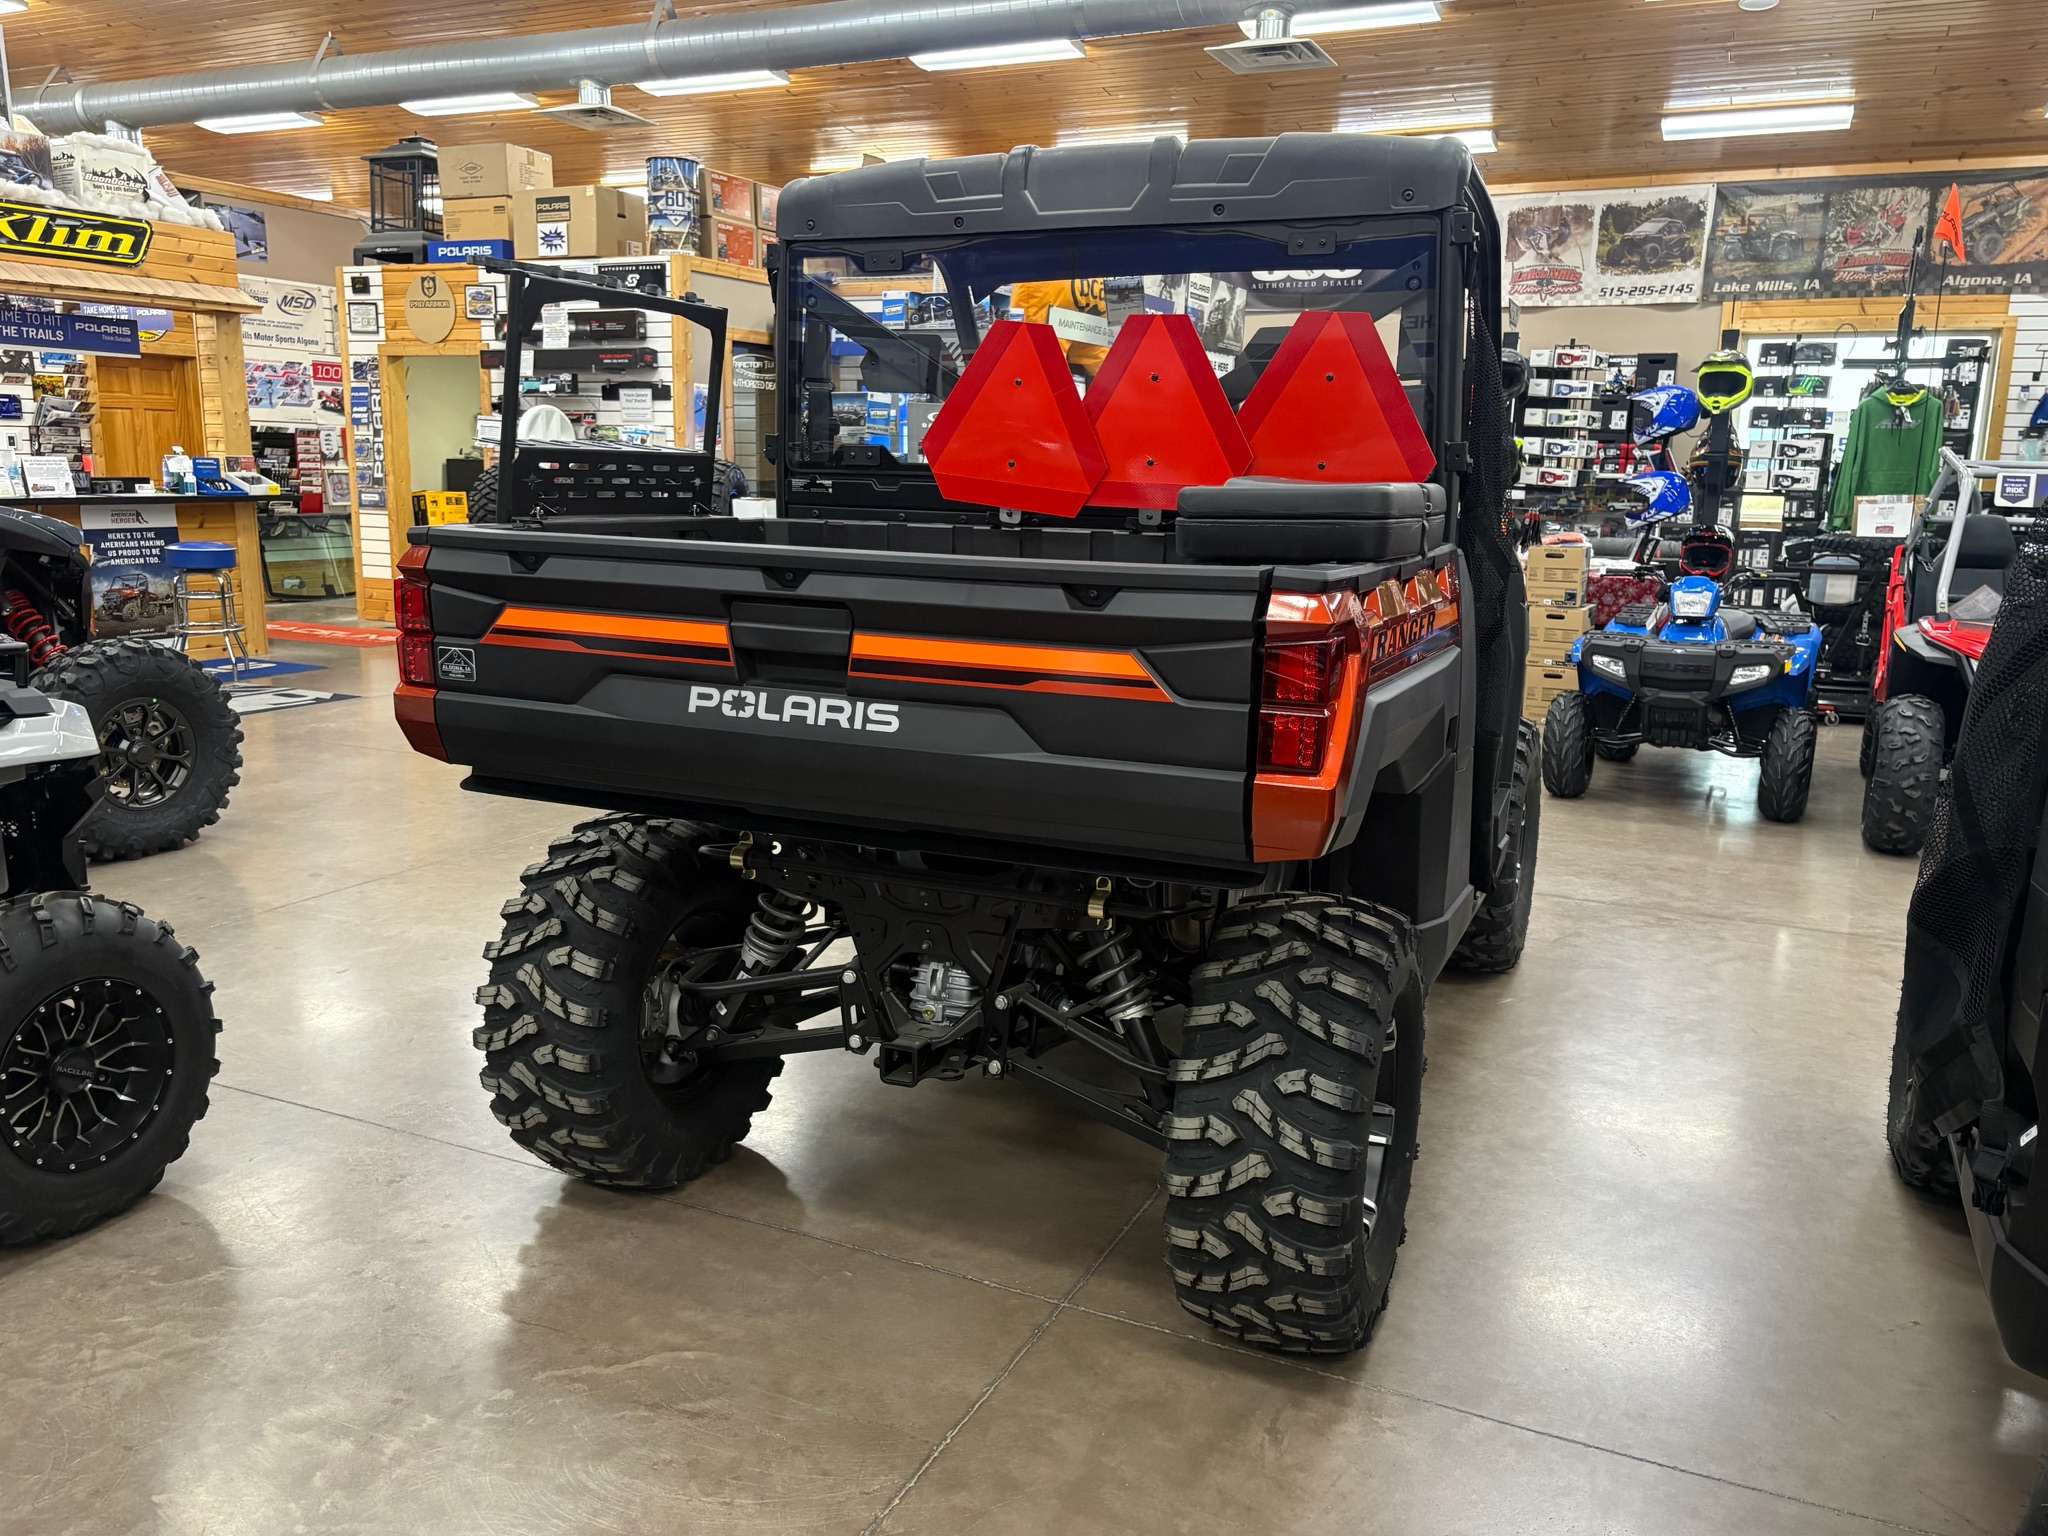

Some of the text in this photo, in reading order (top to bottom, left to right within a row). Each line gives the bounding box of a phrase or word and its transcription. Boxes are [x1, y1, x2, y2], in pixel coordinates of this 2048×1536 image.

[83, 173, 147, 190] BoonDocker
[666, 190, 685, 206] 60
[537, 202, 569, 210] POLARIS
[1942, 211, 1960, 246] LARIS
[438, 246, 492, 256] POLARIS
[1513, 268, 1582, 282] Lake Mills
[1942, 273, 2032, 288] Algona, IA
[1190, 282, 1210, 294] POLARIS
[1252, 281, 1316, 290] AUTHORIZED
[1599, 284, 1694, 297] 515-295-2145
[1713, 279, 1820, 292] Lake Mills, IA
[280, 295, 314, 310] MSD
[410, 300, 450, 308] PRO ARMOR
[83, 306, 98, 314] TAKE
[0, 310, 62, 326] IME TO HIT
[75, 322, 131, 335] POLARIS
[1058, 318, 1103, 335] MAINTENANCE
[22, 327, 64, 341] TRAILS
[242, 331, 318, 346] ills Motor Sports Algona
[316, 366, 341, 378] 100
[1640, 508, 1656, 519] FLY
[1377, 610, 1436, 661] RANGER
[1643, 663, 1712, 674] POLARIS
[688, 686, 900, 733] POLARIS
[57, 1066, 94, 1078] RACELINE
